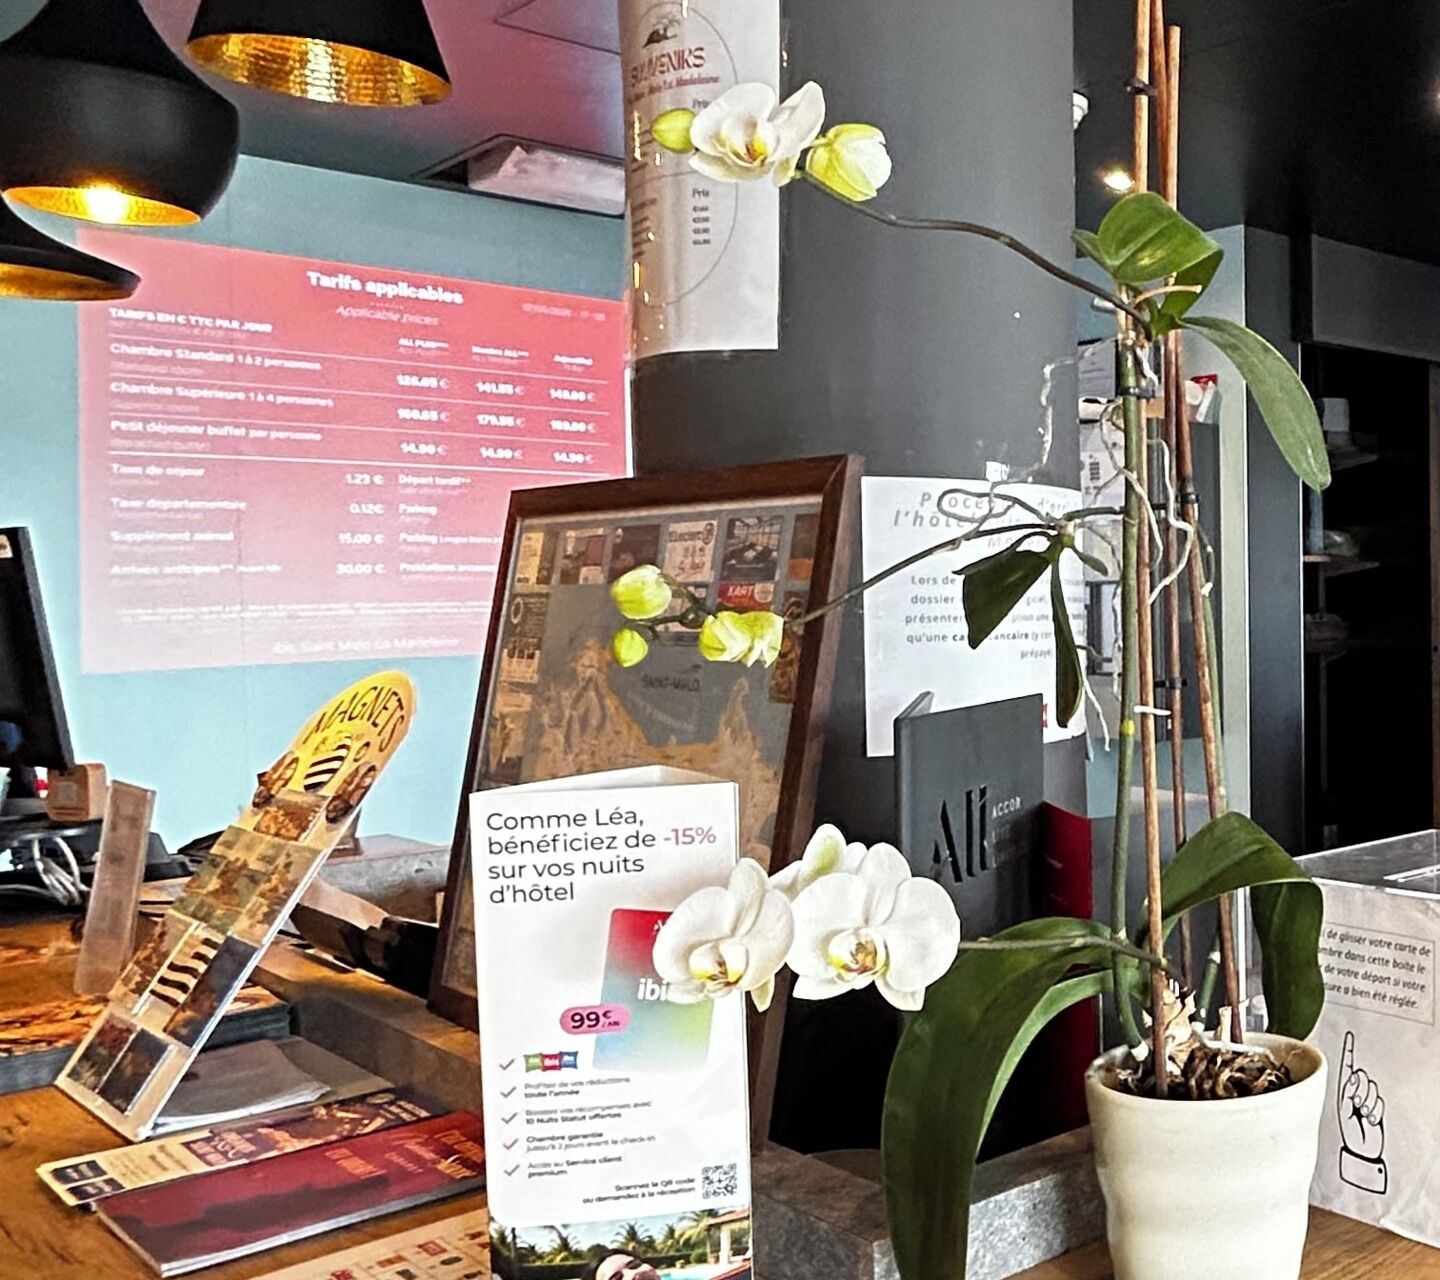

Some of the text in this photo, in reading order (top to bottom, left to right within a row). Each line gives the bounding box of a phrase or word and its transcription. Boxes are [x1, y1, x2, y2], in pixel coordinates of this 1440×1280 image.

[693, 188, 709, 198] Prix
[307, 271, 464, 304] Tarifs applicables
[109, 307, 156, 321] TARIFS
[157, 312, 176, 323] EN
[189, 315, 214, 328] TTC
[215, 318, 241, 330] PAR
[242, 322, 273, 334] JOUR
[336, 305, 400, 322] Applicable
[110, 343, 322, 371] Chambre Standard personnes
[110, 382, 334, 408] Chambre Supérieure personnes
[111, 420, 322, 442] Petit déjeuner buffet par personne
[110, 463, 143, 475] Taxe
[145, 465, 164, 476] de
[372, 474, 384, 486] €
[398, 474, 434, 487] Départ
[110, 497, 144, 509] Taxe
[399, 504, 437, 517] Parking
[338, 533, 385, 546] 15.00 €
[400, 533, 438, 545] Parking
[373, 564, 385, 576] €
[911, 575, 956, 586] Lors de
[910, 594, 955, 604] dossier
[906, 632, 948, 645] qu'une
[991, 632, 1029, 642] ancaire
[302, 685, 405, 753] MAGNETS
[991, 796, 1022, 820] ACCOR
[486, 806, 645, 831] Comme Léa,
[488, 826, 717, 856] bénéficiez de -15%
[931, 784, 989, 884] All
[488, 854, 645, 880] sur vos nuits
[489, 881, 574, 904] d'hôtel
[1327, 929, 1432, 958] de glisser votre carte de
[1344, 949, 1366, 961] dans
[1367, 955, 1391, 968] cette
[1416, 963, 1427, 975] le
[1324, 964, 1427, 993] de votre départ votre
[637, 977, 670, 1002] ibi
[1350, 985, 1371, 999] bien
[1372, 989, 1388, 1003] été
[570, 1009, 613, 1030] 99 €
[575, 1102, 632, 1113] récompenses
[633, 1100, 652, 1108] avec
[560, 1114, 587, 1123] Statut
[589, 1112, 622, 1121] offertes
[526, 1132, 604, 1144] Chambre garantie
[564, 1141, 585, 1151] jours
[586, 1139, 609, 1148] avant
[565, 1158, 597, 1167] Service
[598, 1155, 622, 1164] client
[527, 1169, 568, 1180] premium
[614, 1182, 650, 1192] Scannez
[660, 1179, 673, 1188] QR
[674, 1177, 696, 1186] code
[594, 1192, 640, 1203] demandez
[656, 1187, 696, 1197] réception
